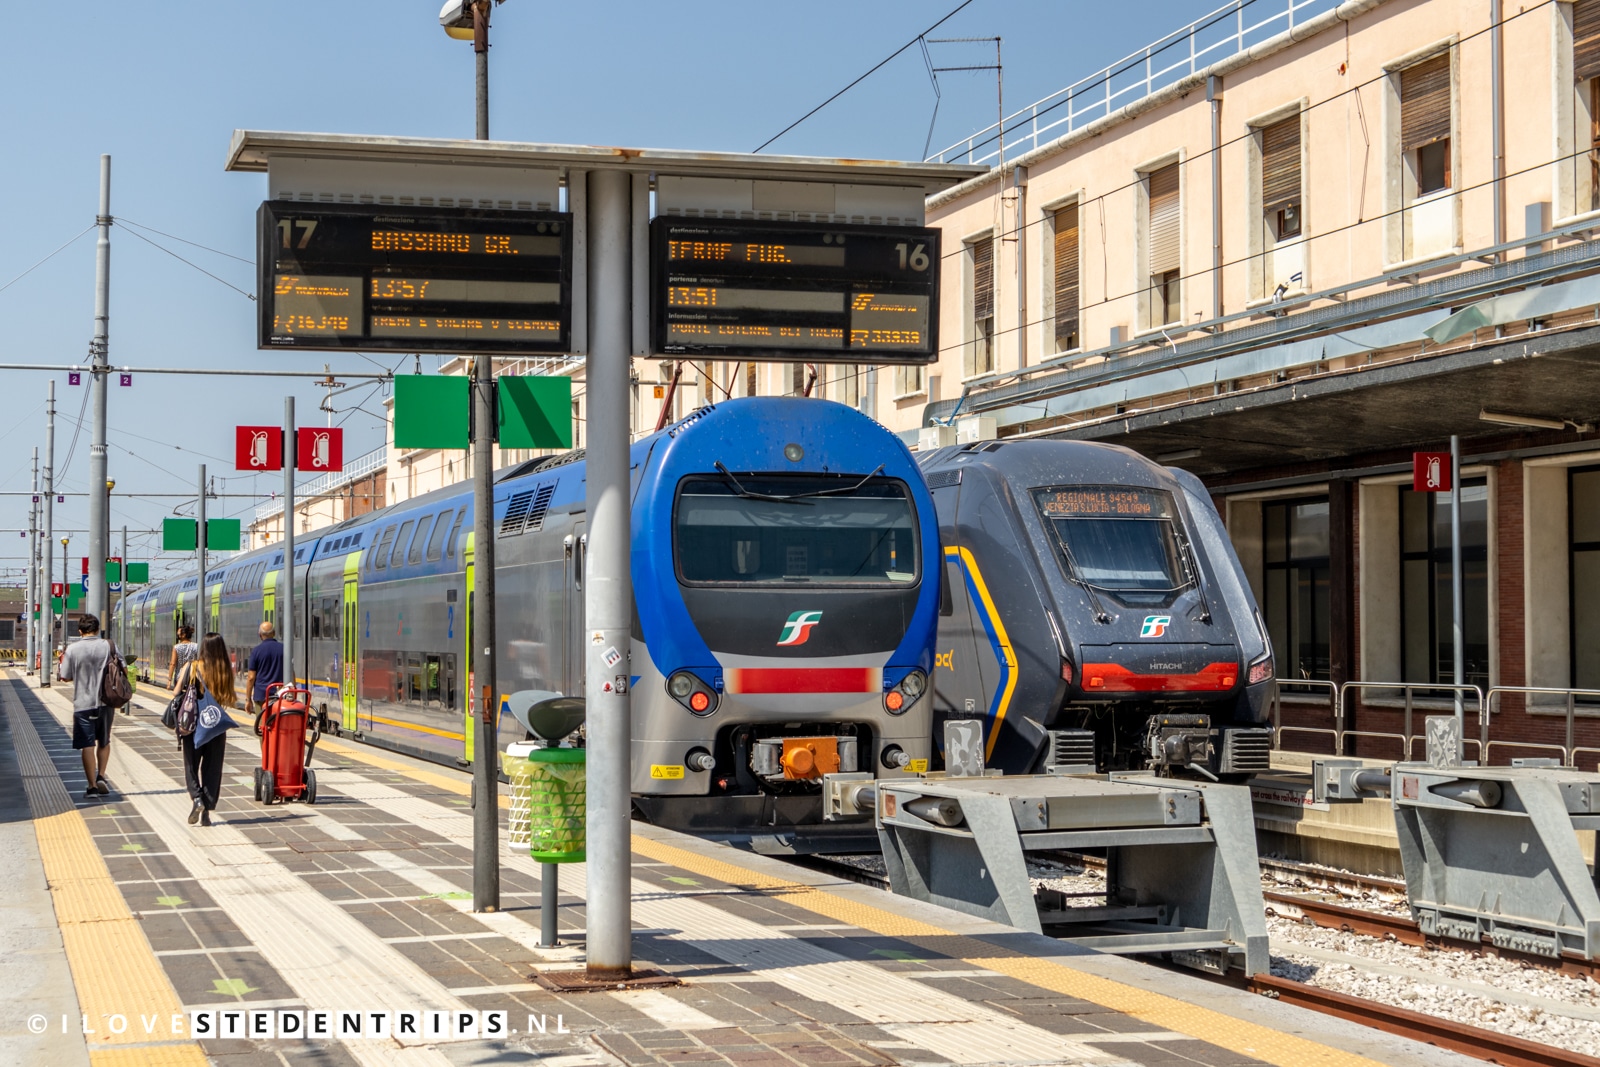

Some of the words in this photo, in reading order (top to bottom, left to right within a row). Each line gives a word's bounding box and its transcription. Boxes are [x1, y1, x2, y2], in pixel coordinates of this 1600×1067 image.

[277, 219, 318, 249] 17
[895, 243, 929, 272] 16
[668, 286, 717, 306] 13:51
[1056, 492, 1106, 503] REGIONALE
[1044, 502, 1079, 512] VENEZIA
[1117, 503, 1151, 514] BOLOGNA
[448, 605, 454, 639] 2
[1281, 793, 1300, 806] railway
